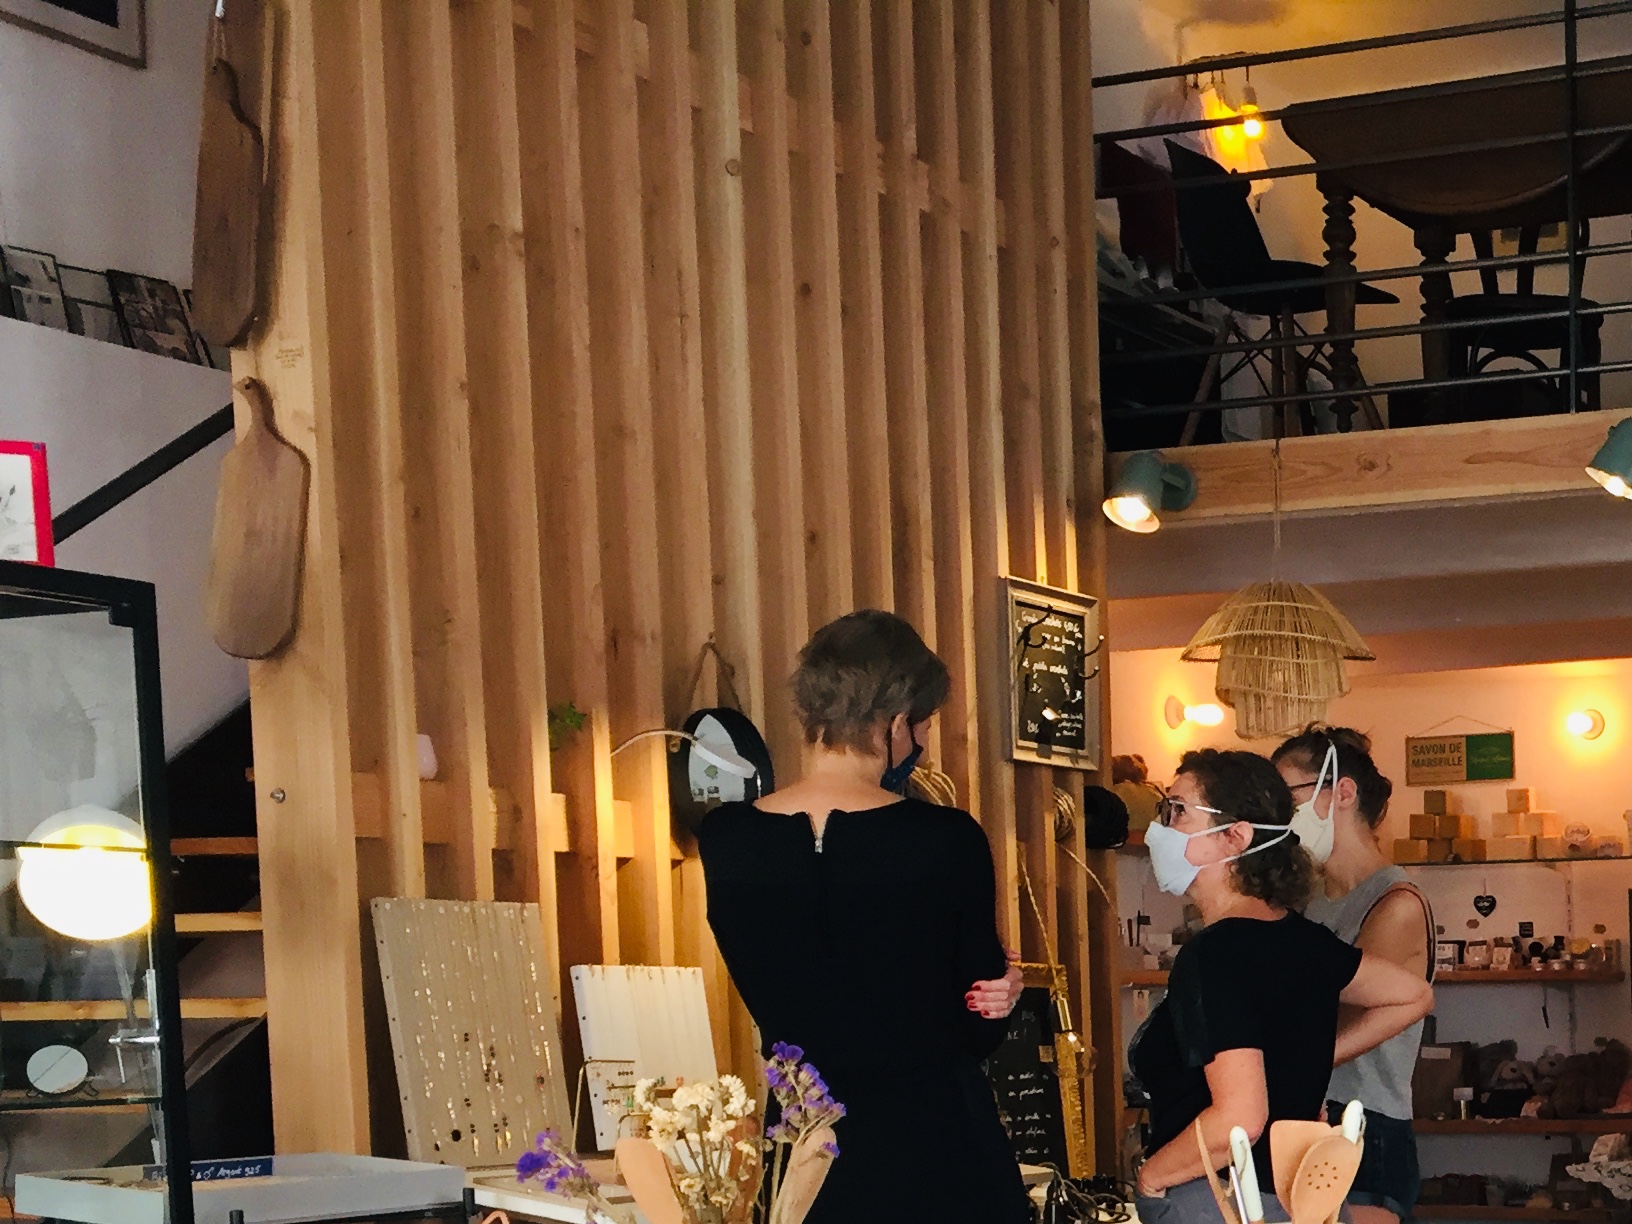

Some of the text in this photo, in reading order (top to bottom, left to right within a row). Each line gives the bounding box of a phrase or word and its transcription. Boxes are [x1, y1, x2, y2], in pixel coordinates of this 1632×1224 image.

[1411, 742, 1463, 756] SAVON DE
[1411, 756, 1463, 768] MARSEILLE
